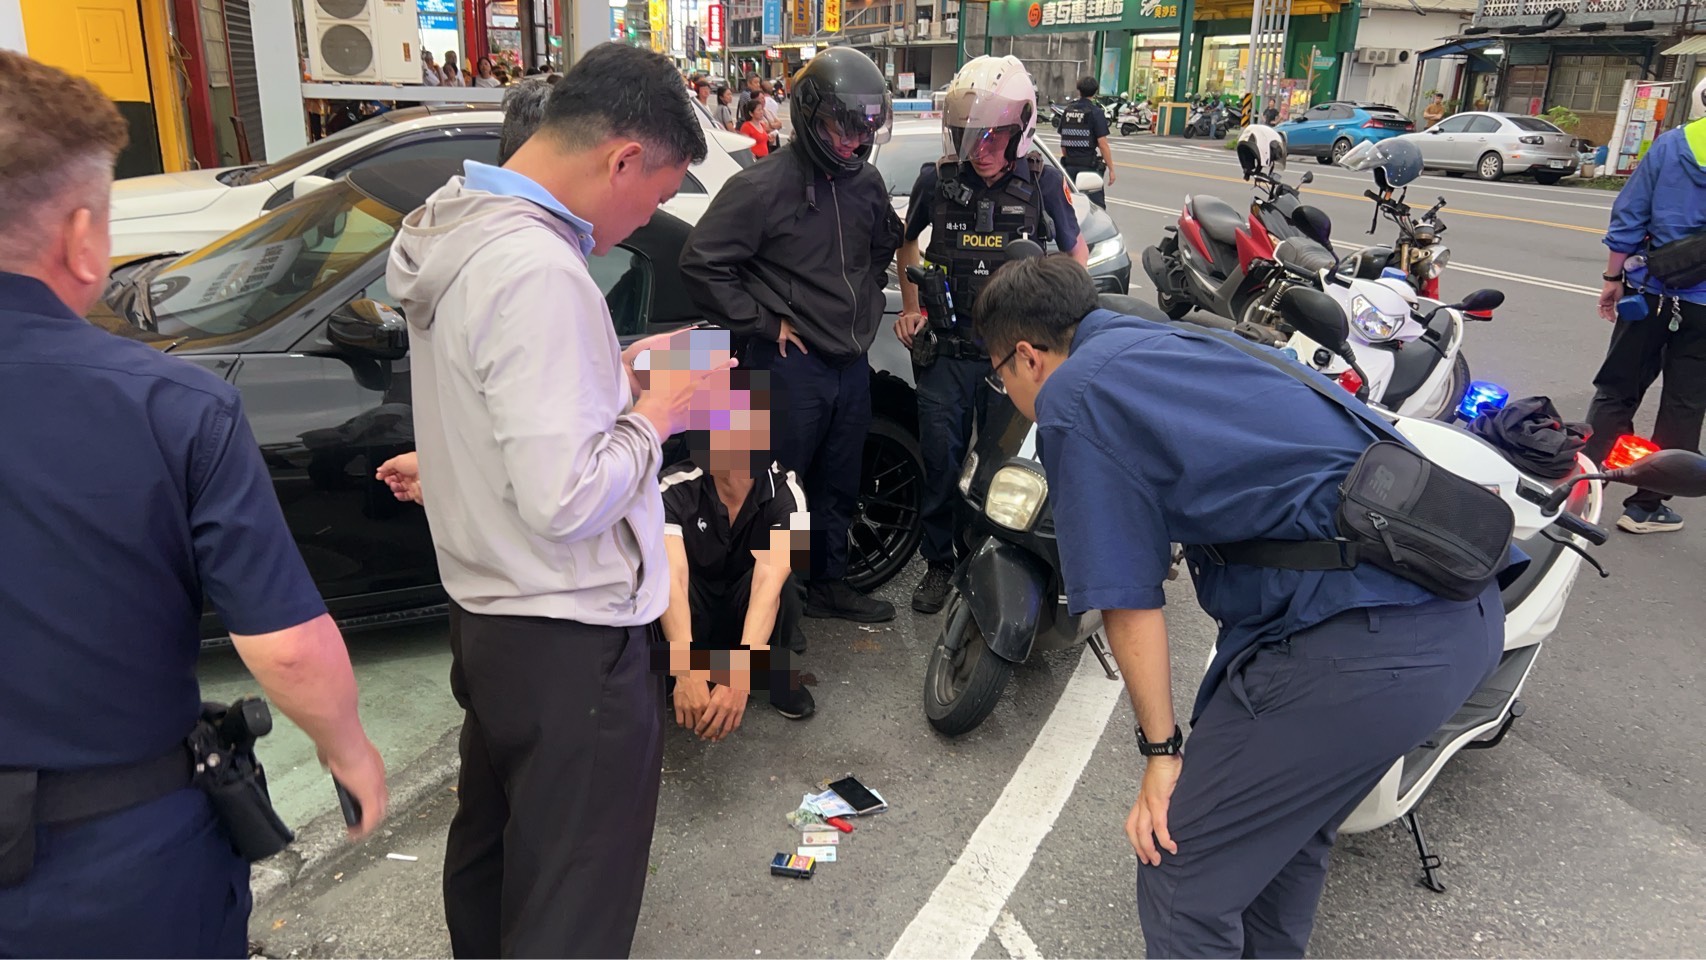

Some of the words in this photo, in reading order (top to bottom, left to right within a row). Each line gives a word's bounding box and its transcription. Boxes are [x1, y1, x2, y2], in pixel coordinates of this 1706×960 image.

[827, 0, 838, 28] 建材
[1042, 1, 1086, 26] 喜互惠
[962, 234, 1003, 248] POLICE
[978, 260, 985, 269] A
